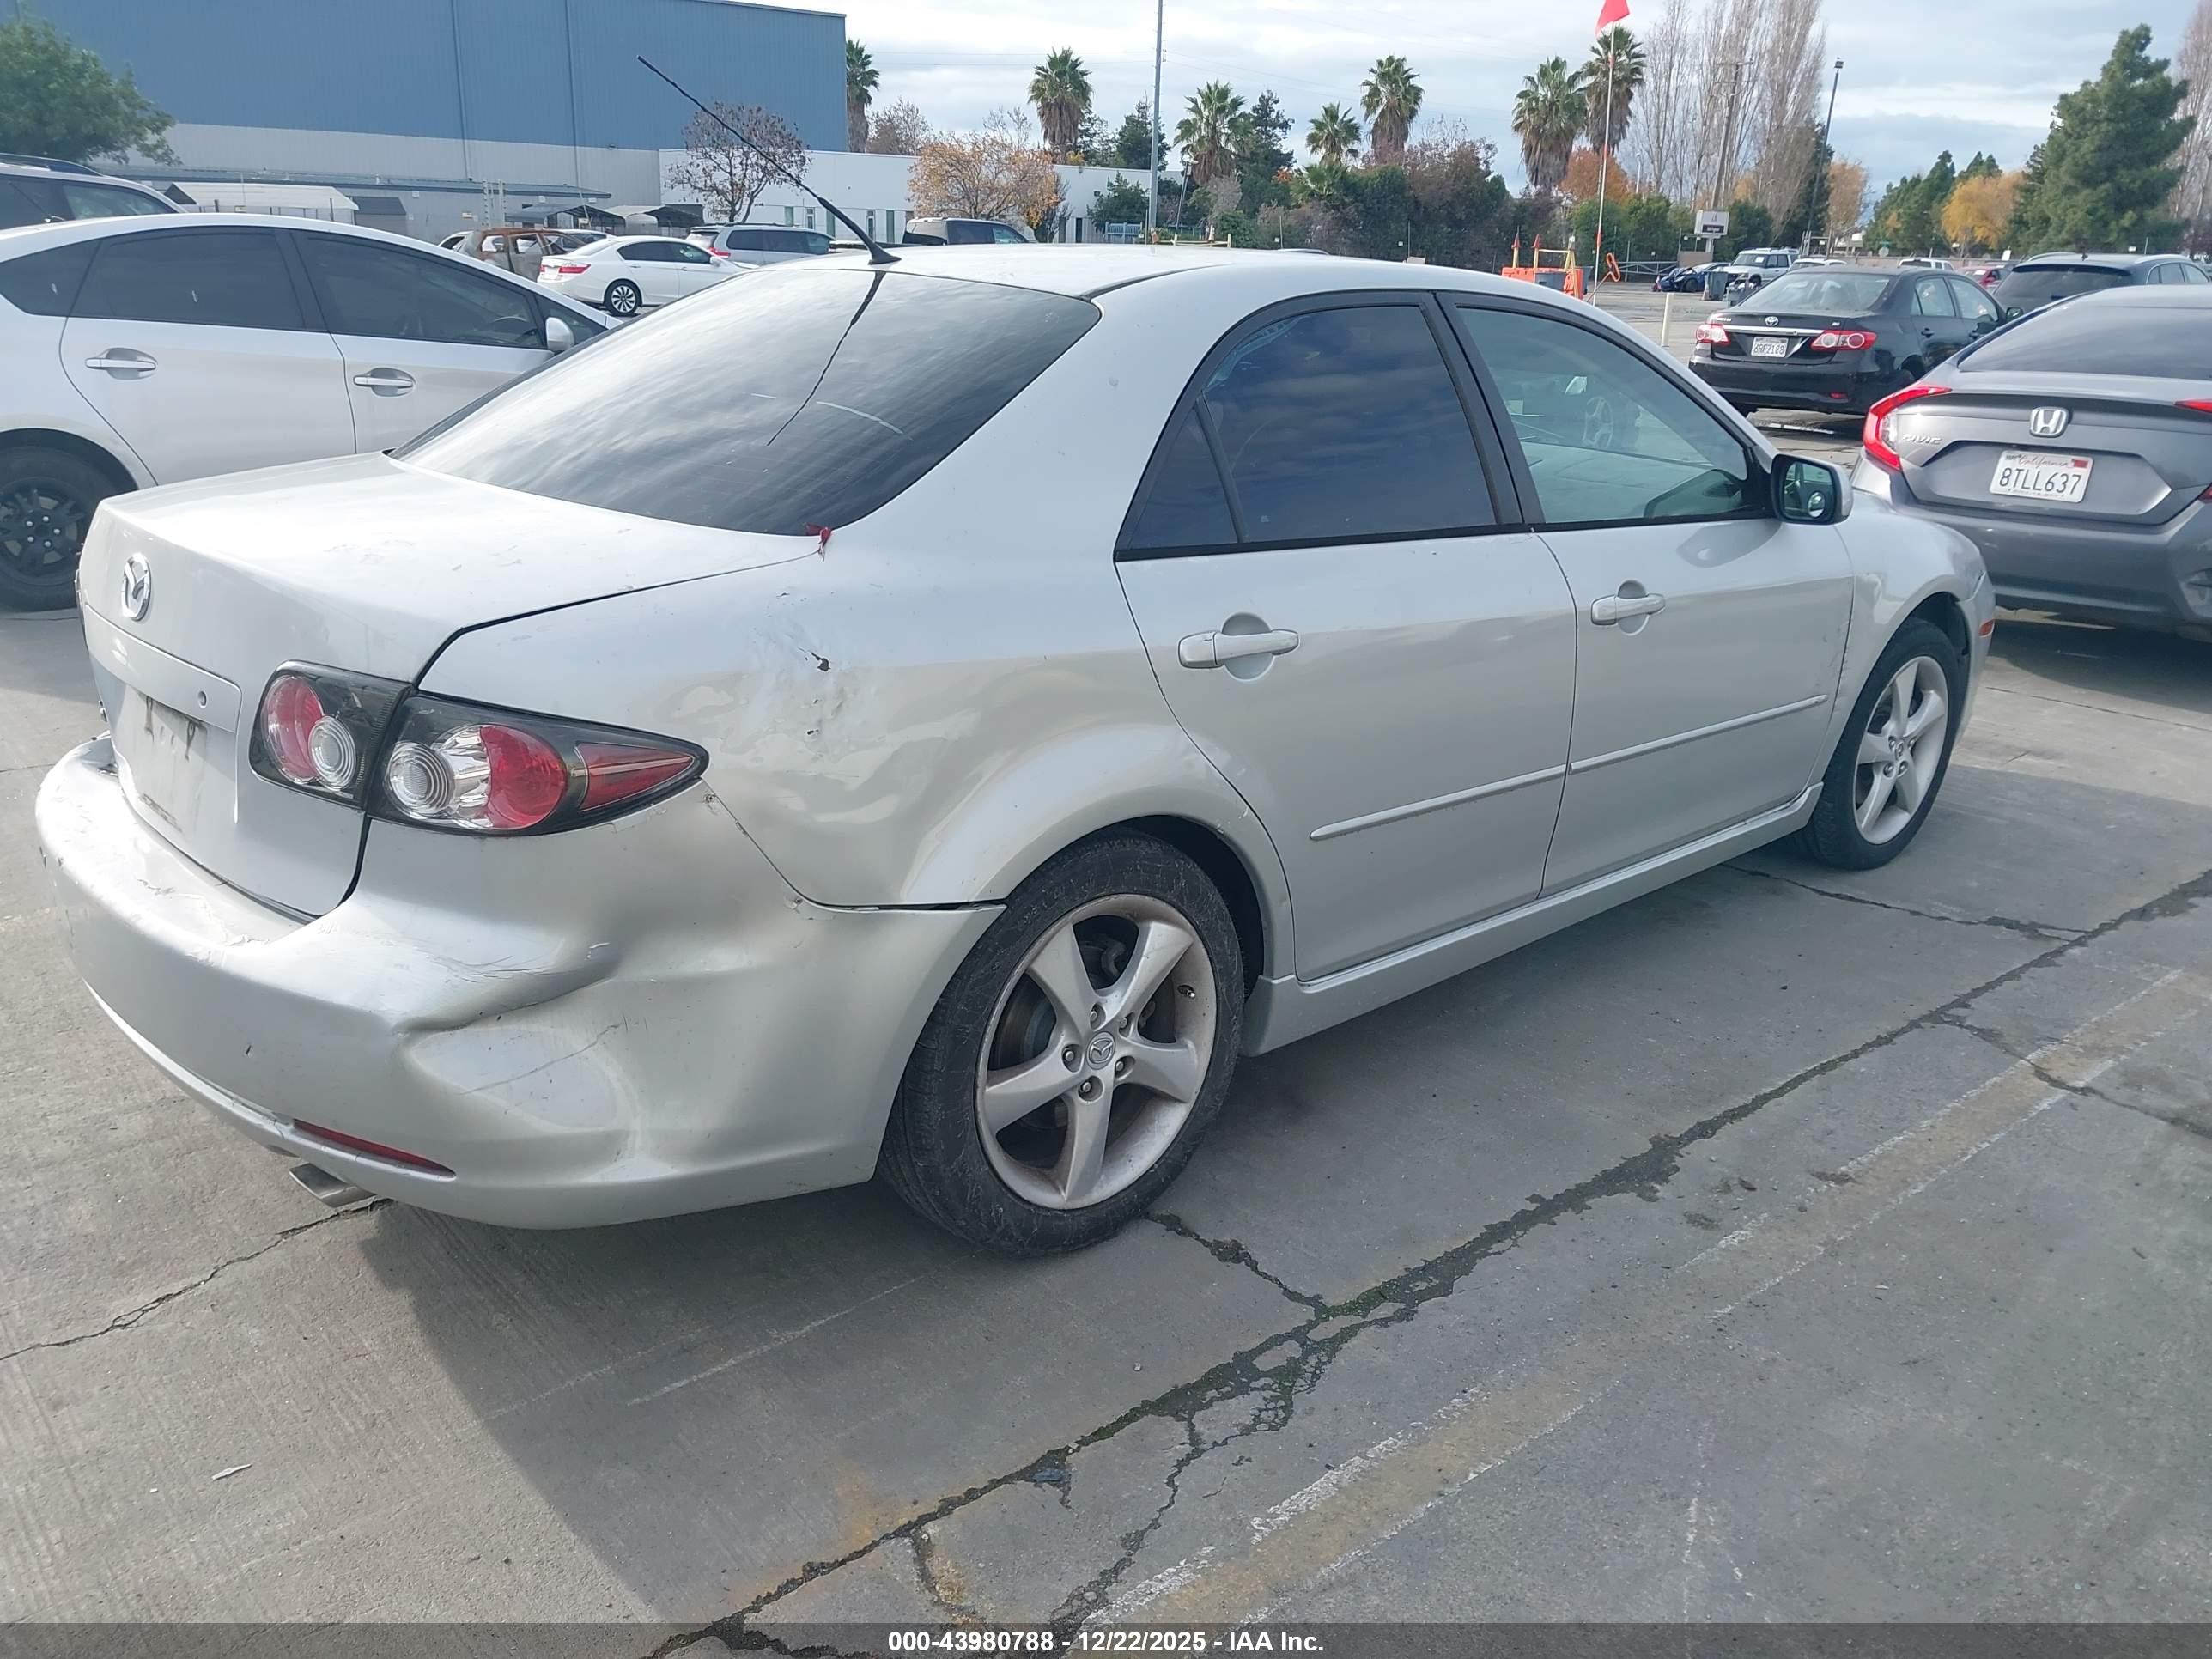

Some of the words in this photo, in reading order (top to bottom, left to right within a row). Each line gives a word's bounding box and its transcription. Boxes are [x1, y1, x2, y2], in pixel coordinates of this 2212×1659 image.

[1902, 434, 1942, 445] CIVIC
[2018, 453, 2069, 468] California
[1999, 467, 2082, 495] 8TLL637
